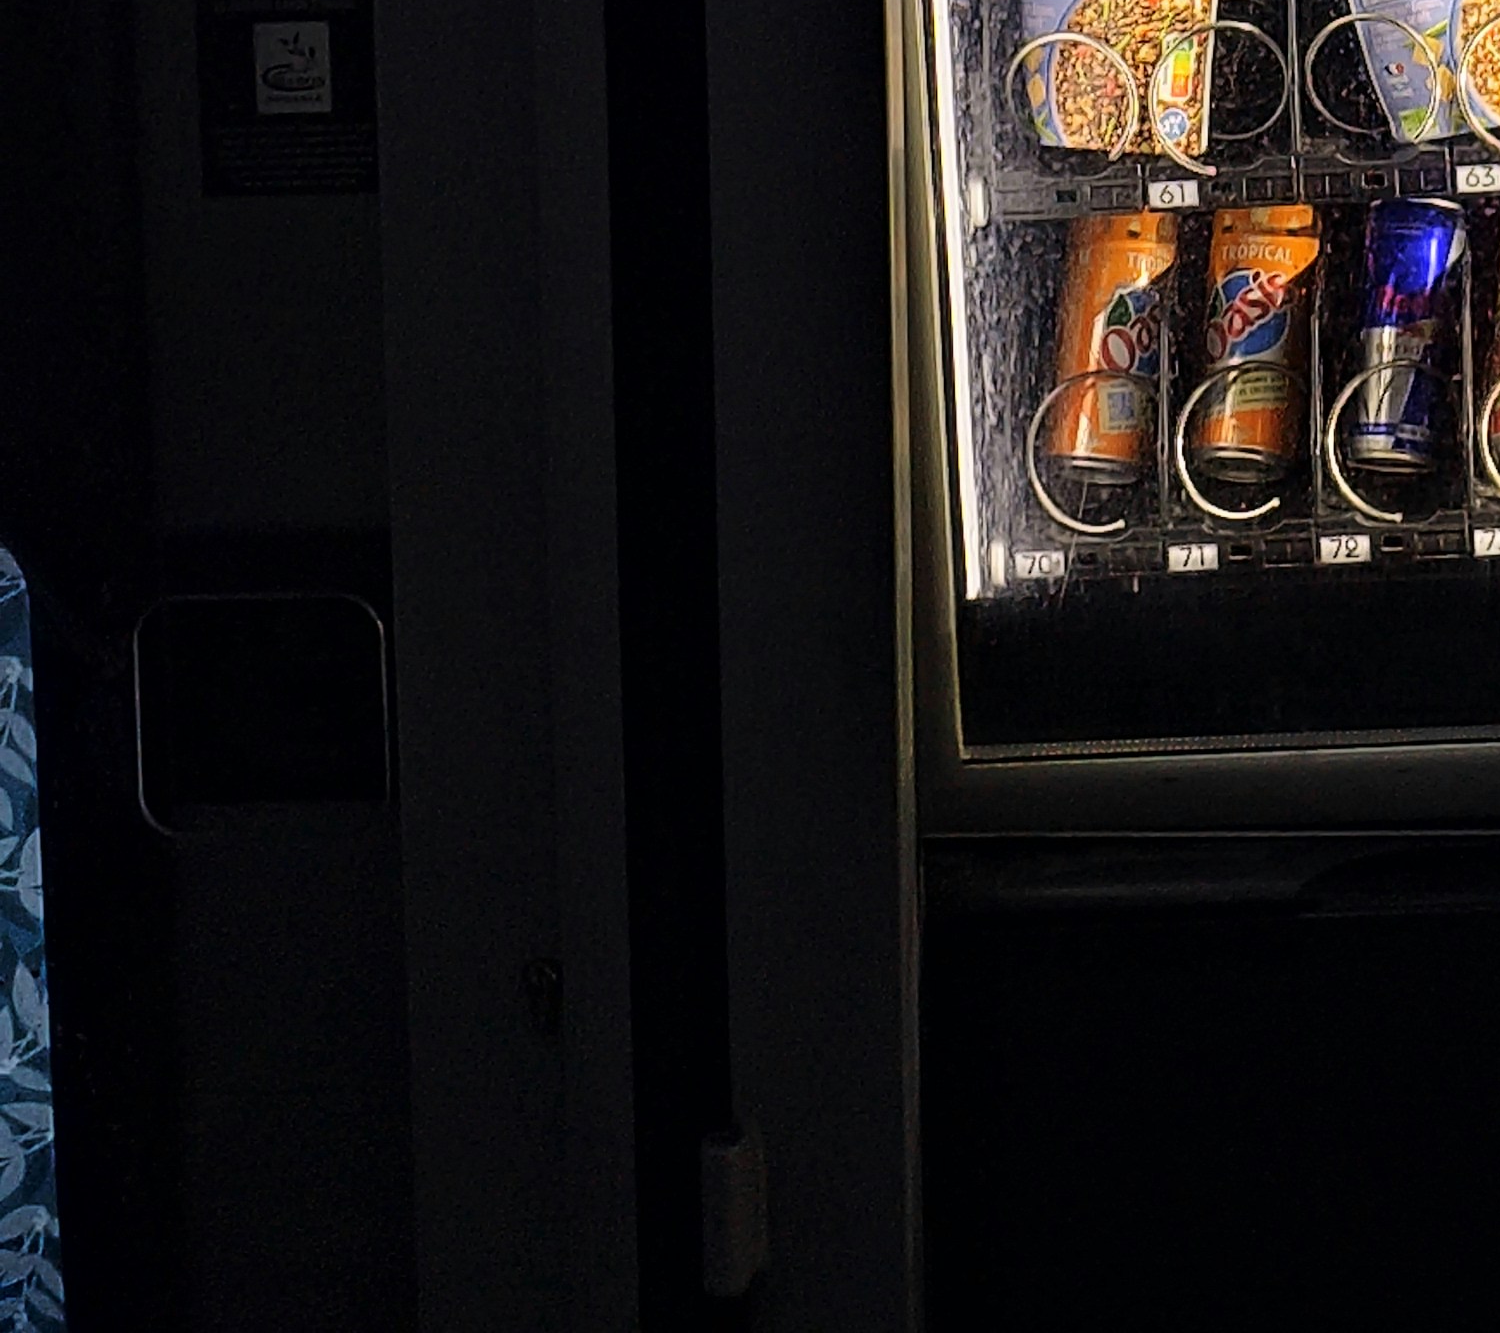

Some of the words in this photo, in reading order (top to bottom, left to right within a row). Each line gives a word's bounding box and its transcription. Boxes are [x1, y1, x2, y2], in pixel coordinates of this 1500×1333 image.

[1465, 166, 1498, 188] 63
[1159, 183, 1188, 205] 61
[1220, 243, 1293, 266] TROPICAL
[1179, 546, 1209, 567] 71
[1329, 537, 1360, 560] 72
[1022, 554, 1052, 574] 70
